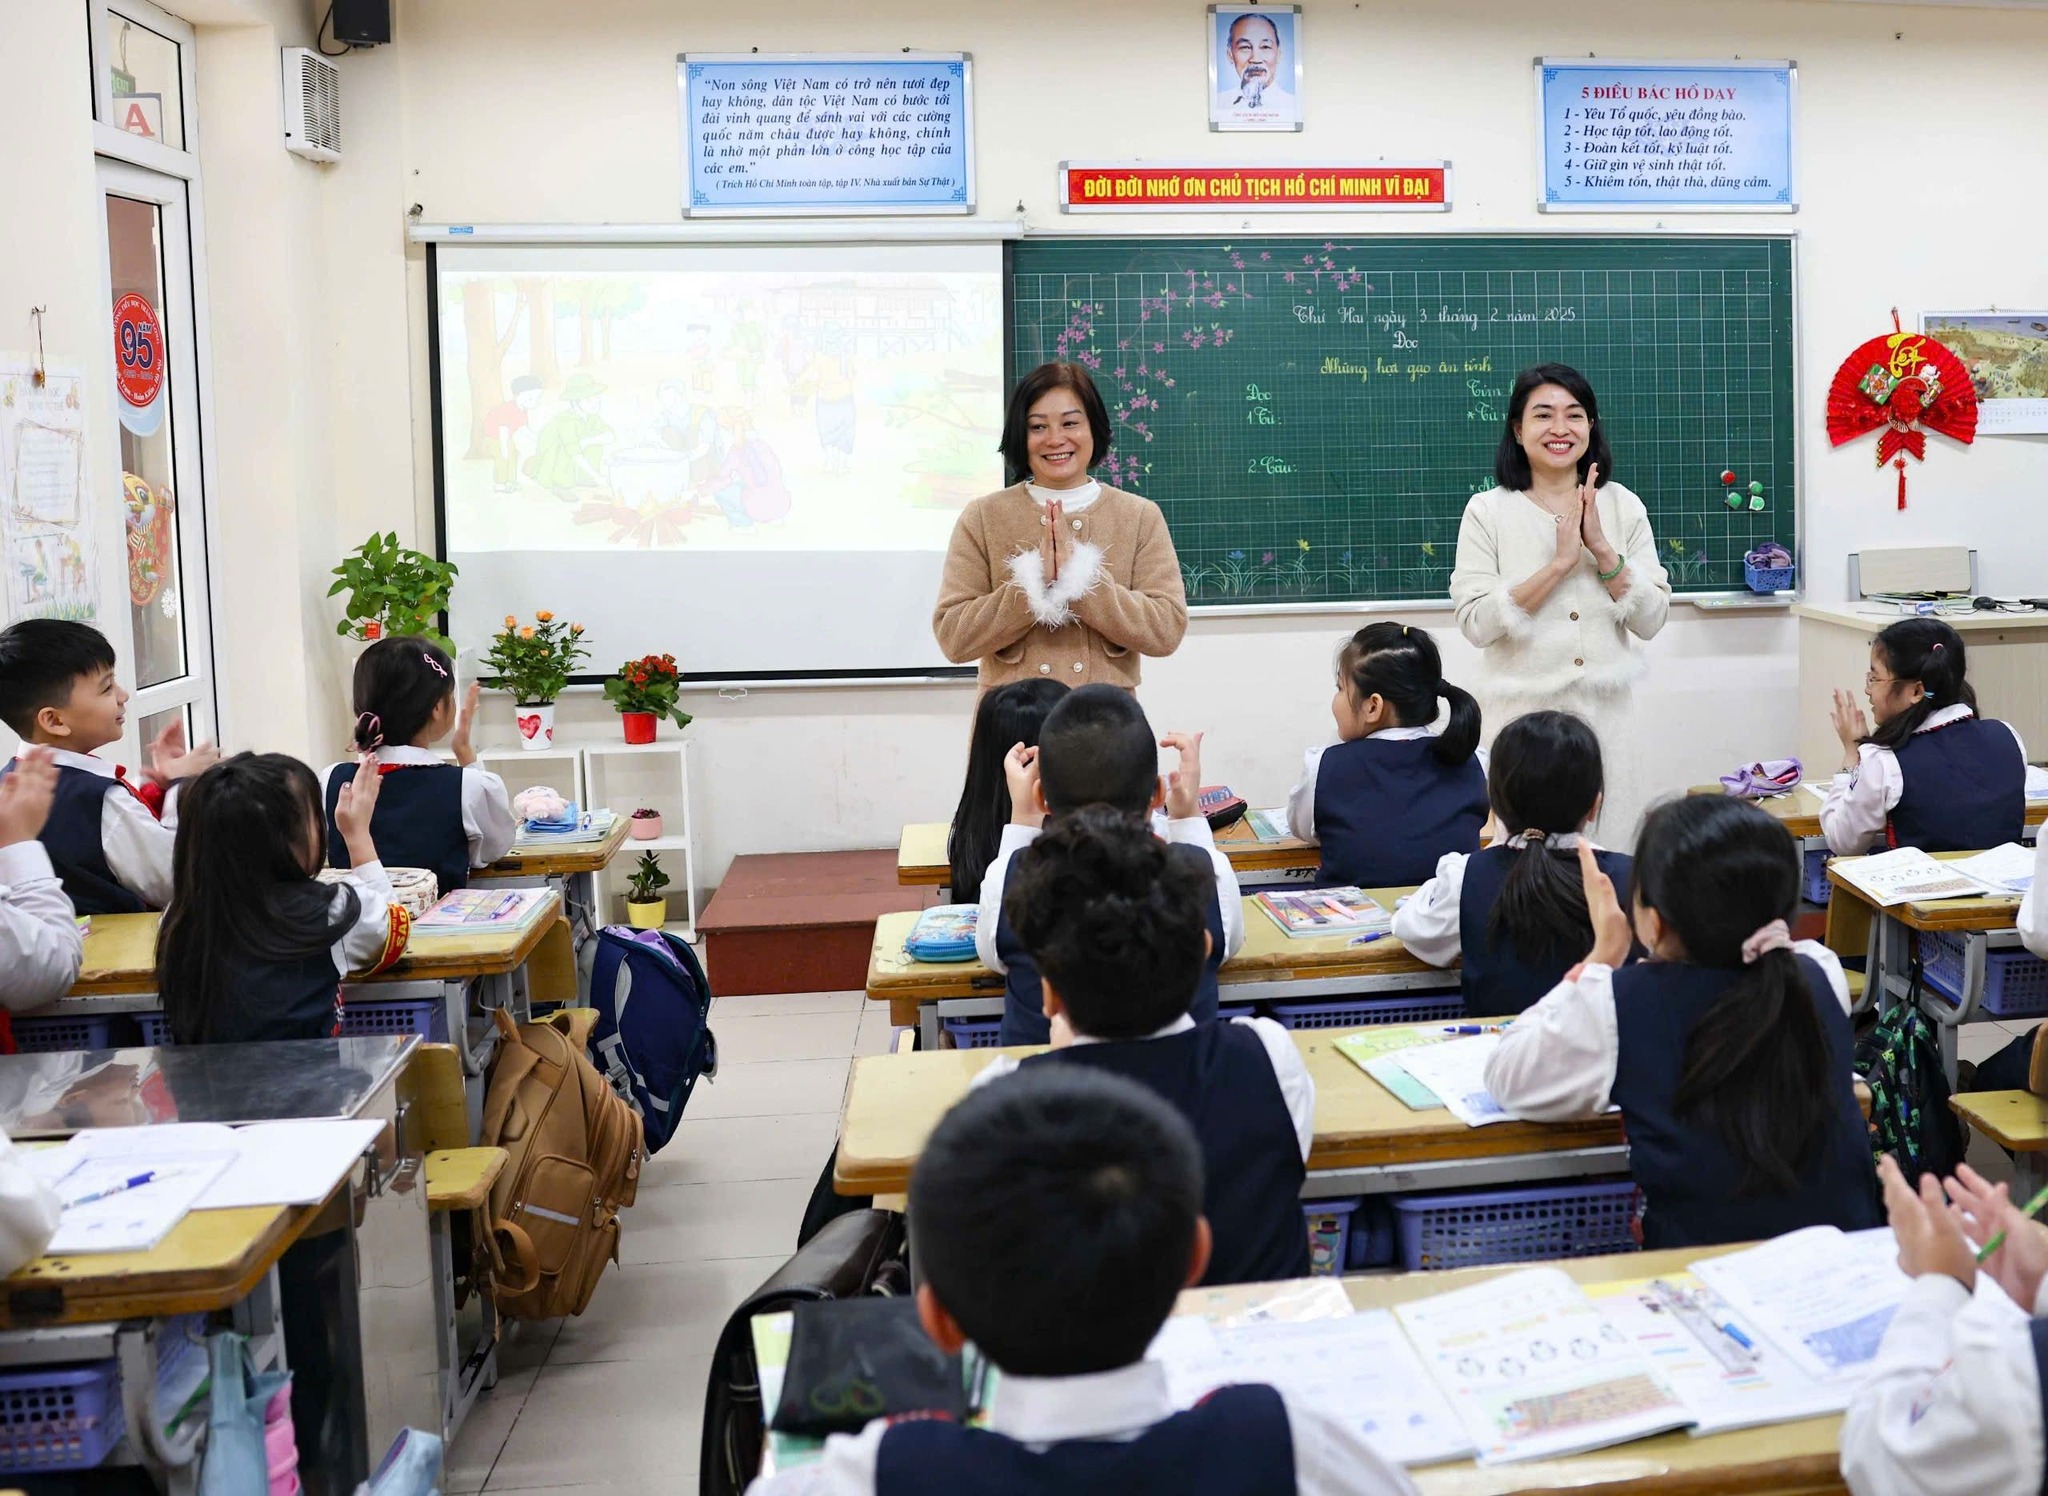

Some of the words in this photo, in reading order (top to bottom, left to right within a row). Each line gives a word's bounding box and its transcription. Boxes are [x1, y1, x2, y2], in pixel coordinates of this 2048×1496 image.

[741, 79, 767, 92] sông
[774, 79, 796, 92] Việt
[803, 79, 829, 90] Nam
[836, 78, 848, 89] có
[854, 78, 871, 89] trở
[876, 78, 896, 89] nên
[903, 78, 925, 89] tươi
[930, 77, 950, 91] đẹp
[1582, 87, 1589, 98] 5
[1594, 81, 1633, 99] ĐIỀU
[1638, 84, 1670, 99] BÁC
[1675, 83, 1699, 99] HỒ
[1704, 87, 1737, 102] DẠY
[702, 96, 722, 110] hay
[728, 96, 766, 109] không,
[772, 96, 792, 107] dân
[800, 95, 816, 108] tộc
[824, 95, 845, 108] Việt
[852, 95, 878, 106] Nam
[884, 95, 897, 105] có
[903, 95, 929, 105] bước
[935, 94, 950, 105] tới
[123, 103, 155, 137] A
[702, 112, 720, 124] đài
[726, 112, 750, 123] vinh
[756, 115, 791, 125] quang
[797, 109, 811, 122] để
[815, 112, 842, 122] sánh
[849, 112, 864, 122] vai
[871, 111, 886, 122] với
[893, 111, 911, 122] các
[917, 110, 951, 124] cường
[1564, 108, 1570, 119] 1
[1584, 108, 1605, 119] Yêu
[1610, 106, 1627, 119] Tổ
[1629, 107, 1661, 122] quốc,
[1664, 109, 1685, 122] yêu
[1689, 107, 1718, 122] đồng
[1722, 109, 1745, 120] bào.
[703, 127, 732, 143] quốc
[739, 130, 763, 140] năm
[771, 129, 800, 140] châu
[806, 128, 835, 141] được
[842, 128, 863, 141] hay
[869, 128, 910, 140] không,
[917, 127, 950, 138] chính
[1564, 125, 1571, 136] 2
[1584, 125, 1608, 138] Học
[1612, 125, 1631, 139] tập
[1635, 123, 1655, 137] tốt,
[1659, 126, 1677, 136] lao
[1681, 126, 1709, 139] động
[1714, 124, 1733, 137] tốt.
[704, 146, 714, 157] là
[721, 146, 743, 157] nhờ
[749, 146, 770, 158] một
[776, 143, 805, 159] phần
[812, 145, 829, 155] lớn
[849, 144, 875, 157] công
[881, 144, 901, 157] học
[908, 144, 925, 157] tập
[931, 143, 951, 154] của
[1564, 142, 1571, 153] 3
[1584, 142, 1617, 153] Đoàn
[1621, 140, 1639, 153] kết
[1644, 140, 1663, 154] tốt,
[1686, 142, 1709, 155] luật
[1714, 141, 1733, 154] tốt.
[704, 162, 723, 174] các
[1565, 159, 1572, 170] 4
[1584, 159, 1607, 170] Giữ
[1610, 161, 1628, 172] gìn
[1633, 159, 1645, 172] vệ
[1649, 160, 1673, 170] sinh
[1678, 160, 1702, 172] thật
[1707, 157, 1726, 170] tốt.
[746, 178, 757, 188] Hồ
[760, 180, 774, 188] Chí
[836, 178, 848, 189] tập
[864, 178, 880, 186] Nhà
[1084, 176, 1111, 197] ĐỜI
[1116, 176, 1142, 197] ĐỜI
[1147, 176, 1180, 197] NHỚ
[1184, 178, 1205, 197] ƠN
[1210, 173, 1242, 197] CHỦ
[1245, 178, 1280, 200] TỊCH
[1285, 173, 1305, 196] HỒ
[1310, 175, 1335, 196] CHÍ
[1340, 178, 1381, 196] MINH
[1385, 173, 1399, 196] VĨ
[1403, 178, 1429, 199] ĐẠI
[1565, 176, 1572, 187] 5
[1585, 176, 1624, 187] Khiêm
[1629, 174, 1651, 188] tốn,
[1656, 176, 1680, 189] thật
[1685, 176, 1707, 188] thà,
[1711, 176, 1740, 189] dũng
[1744, 176, 1771, 187] cảm.
[1374, 311, 1406, 331] ngày
[1420, 308, 1427, 322] 3
[1439, 305, 1478, 331] tháng
[1491, 308, 1499, 322] 2
[1506, 309, 1537, 322] năm
[1545, 307, 1575, 322] 2025
[120, 319, 153, 369] 95
[1393, 330, 1418, 352] Đọc
[1320, 357, 1368, 383] Những
[1377, 358, 1398, 376] hạt
[1408, 363, 1430, 382] gạo
[1439, 361, 1457, 373] ân
[1246, 384, 1272, 403] Đọc
